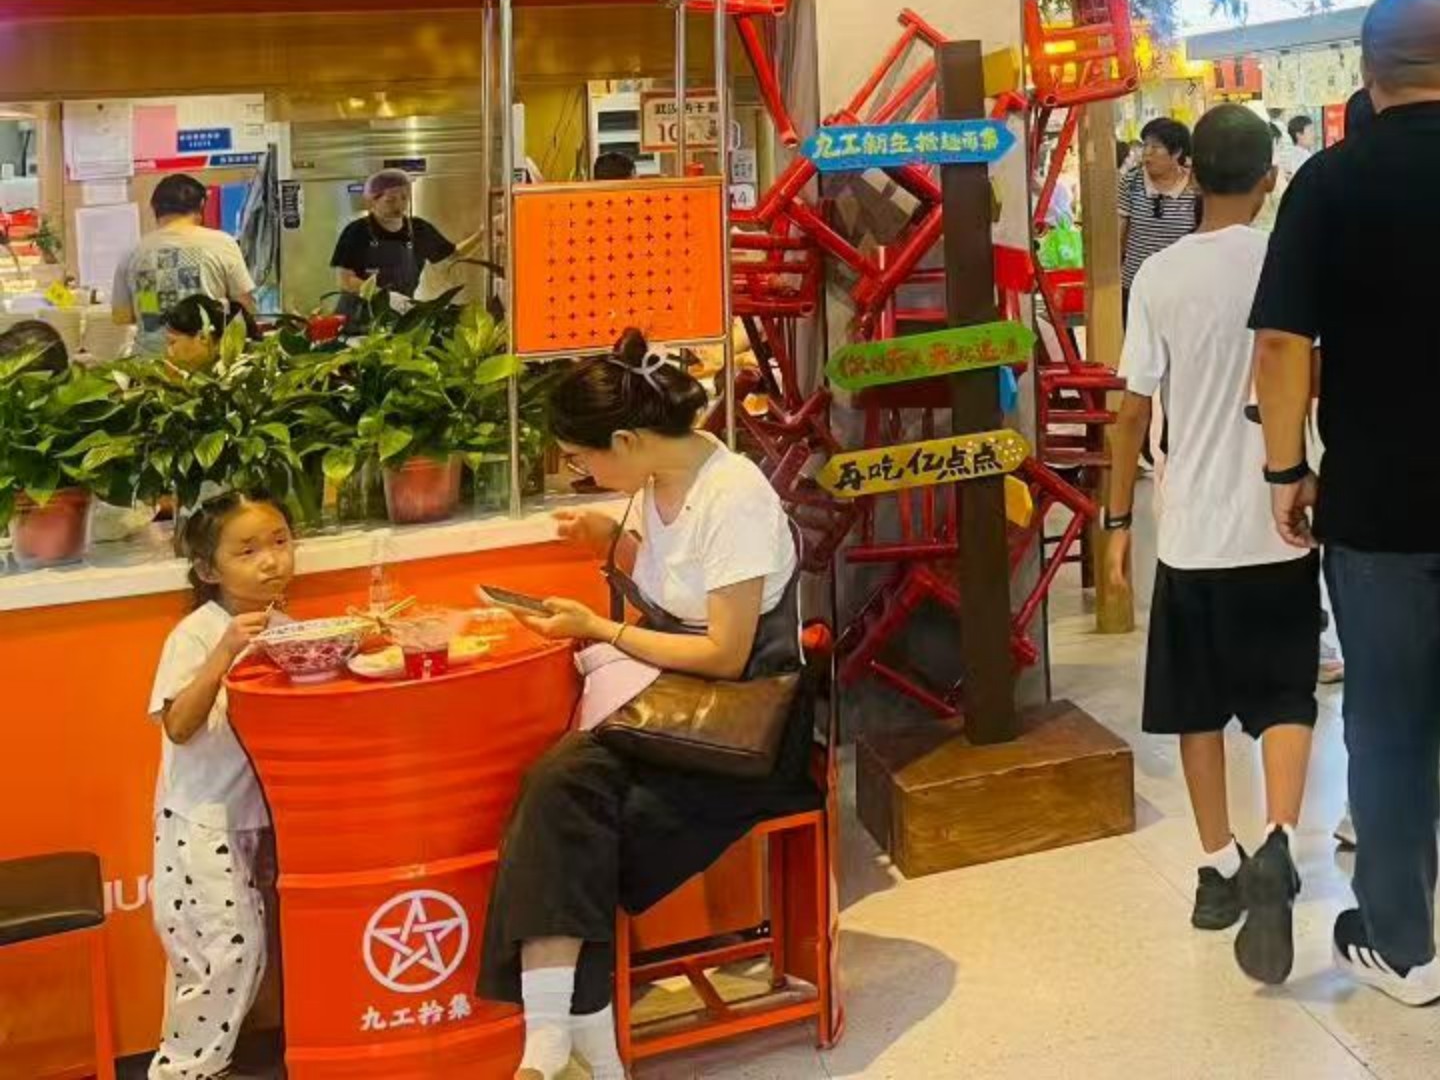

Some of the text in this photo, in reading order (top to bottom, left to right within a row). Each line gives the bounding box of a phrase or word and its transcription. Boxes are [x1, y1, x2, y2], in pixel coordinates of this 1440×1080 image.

[834, 442, 1003, 491] 再吃亿点点
[360, 993, 472, 1031] 九工拾集
